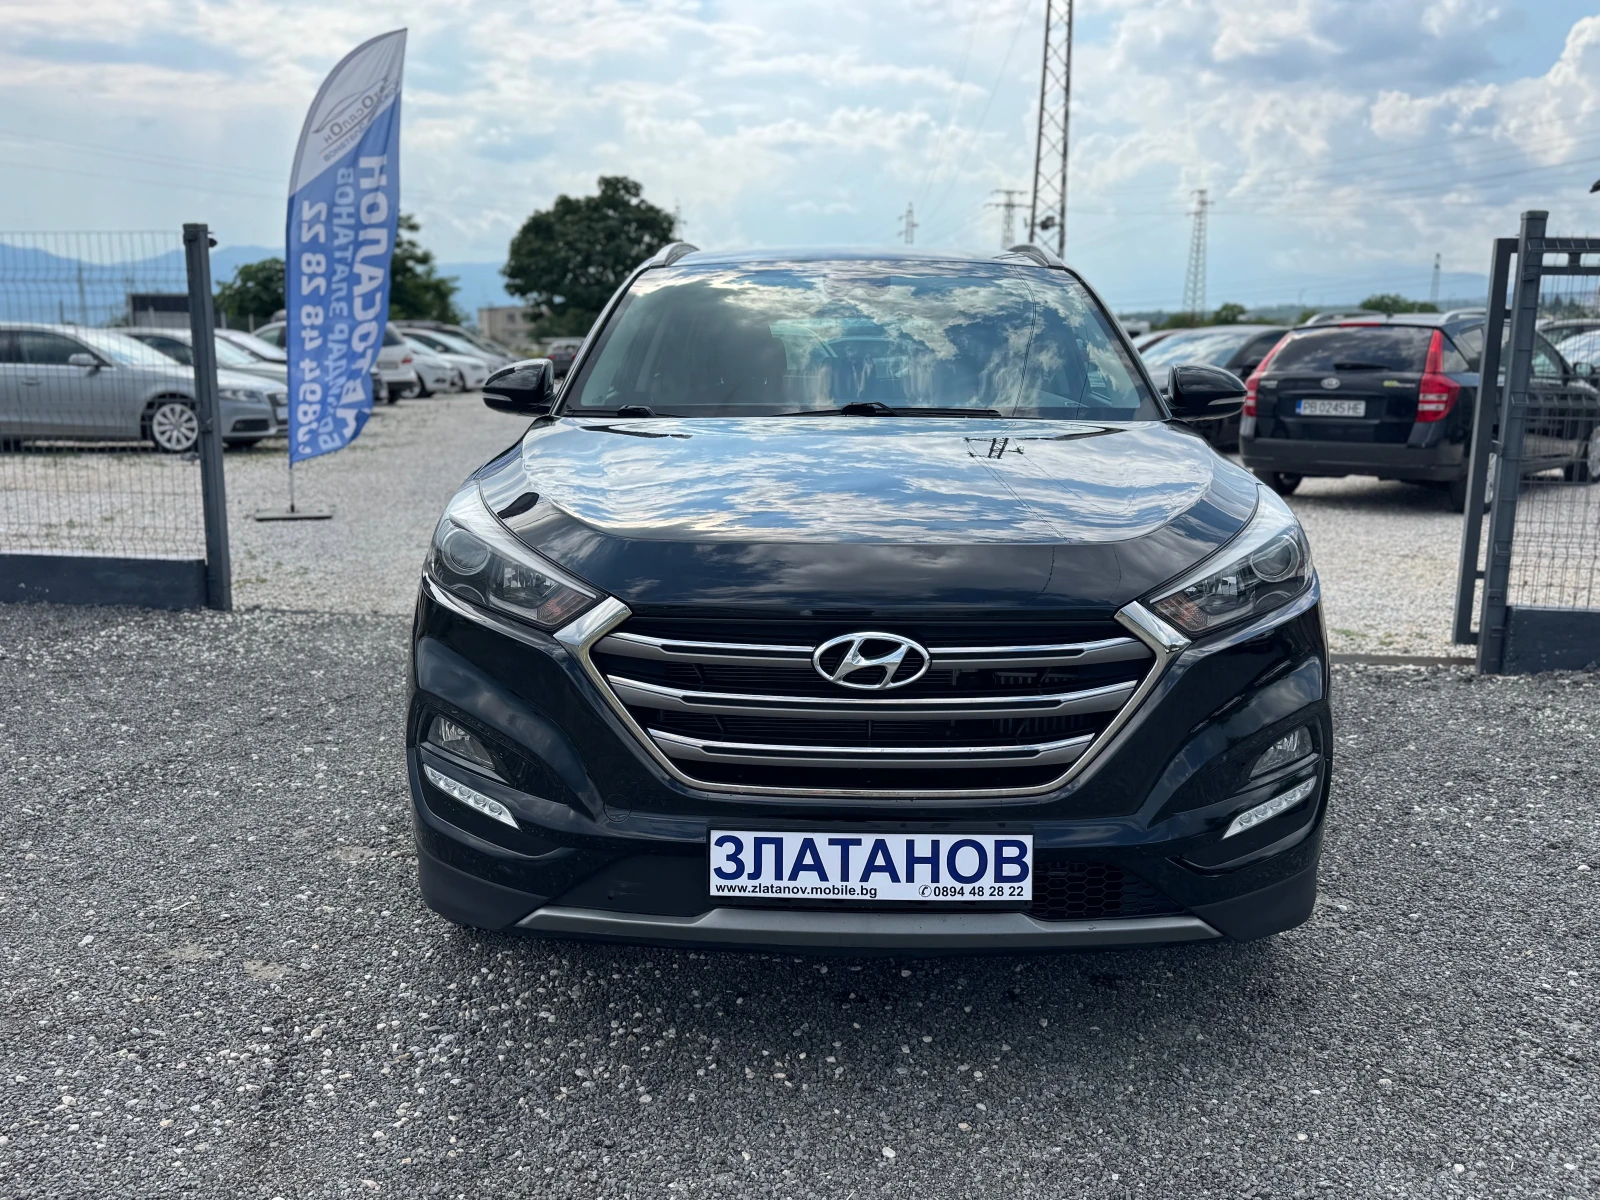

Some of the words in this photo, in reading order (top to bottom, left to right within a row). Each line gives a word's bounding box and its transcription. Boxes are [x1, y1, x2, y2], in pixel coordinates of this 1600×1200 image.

[713, 835, 1030, 884] ЗЛАТАНОВ
[715, 883, 877, 898] www.zlatanov.mobile.bg
[933, 886, 965, 897] 0894
[969, 886, 985, 897] 48
[988, 886, 1004, 897] 28
[1008, 886, 1024, 897] 22
